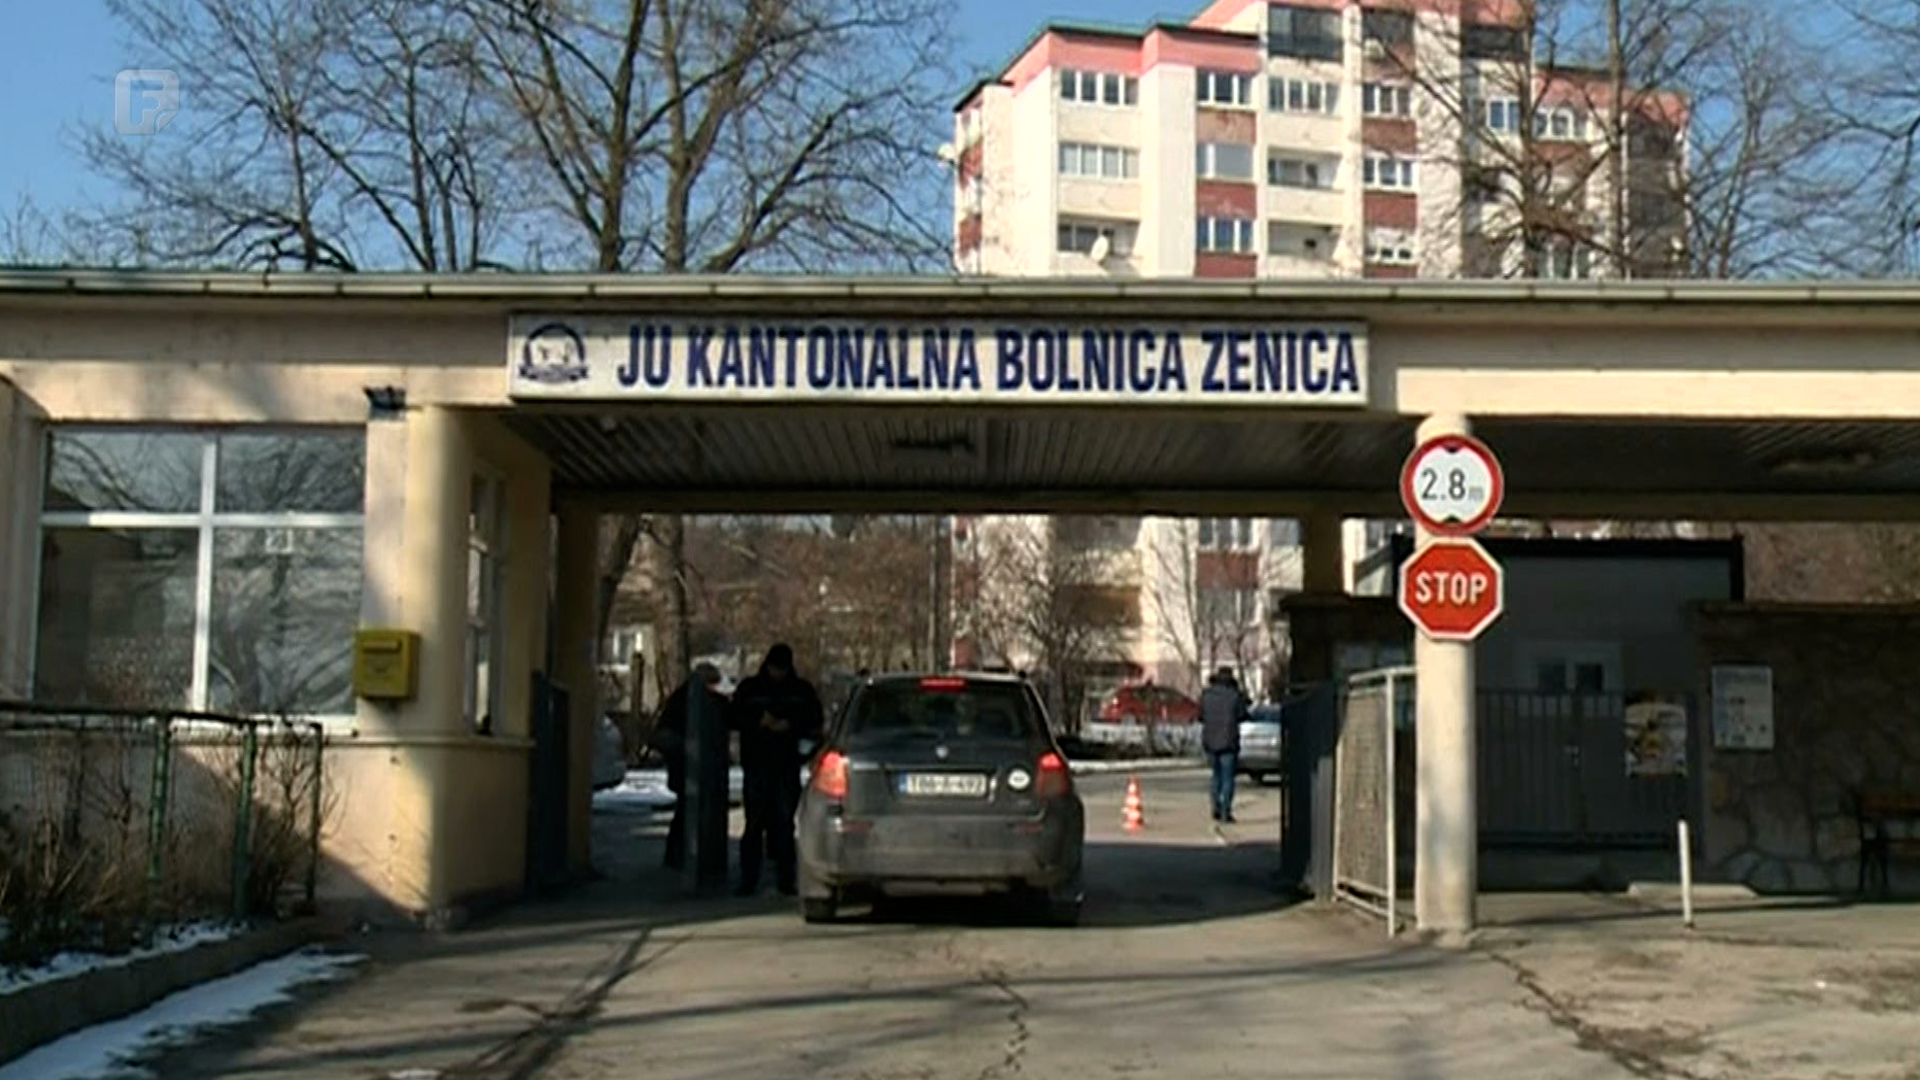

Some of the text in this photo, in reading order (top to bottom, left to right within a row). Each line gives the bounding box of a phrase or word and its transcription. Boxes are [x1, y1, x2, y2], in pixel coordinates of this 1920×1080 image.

[617, 324, 1360, 394] JU KANTONALNA BOLNICA ZENICA
[1414, 570, 1489, 606] STOP
